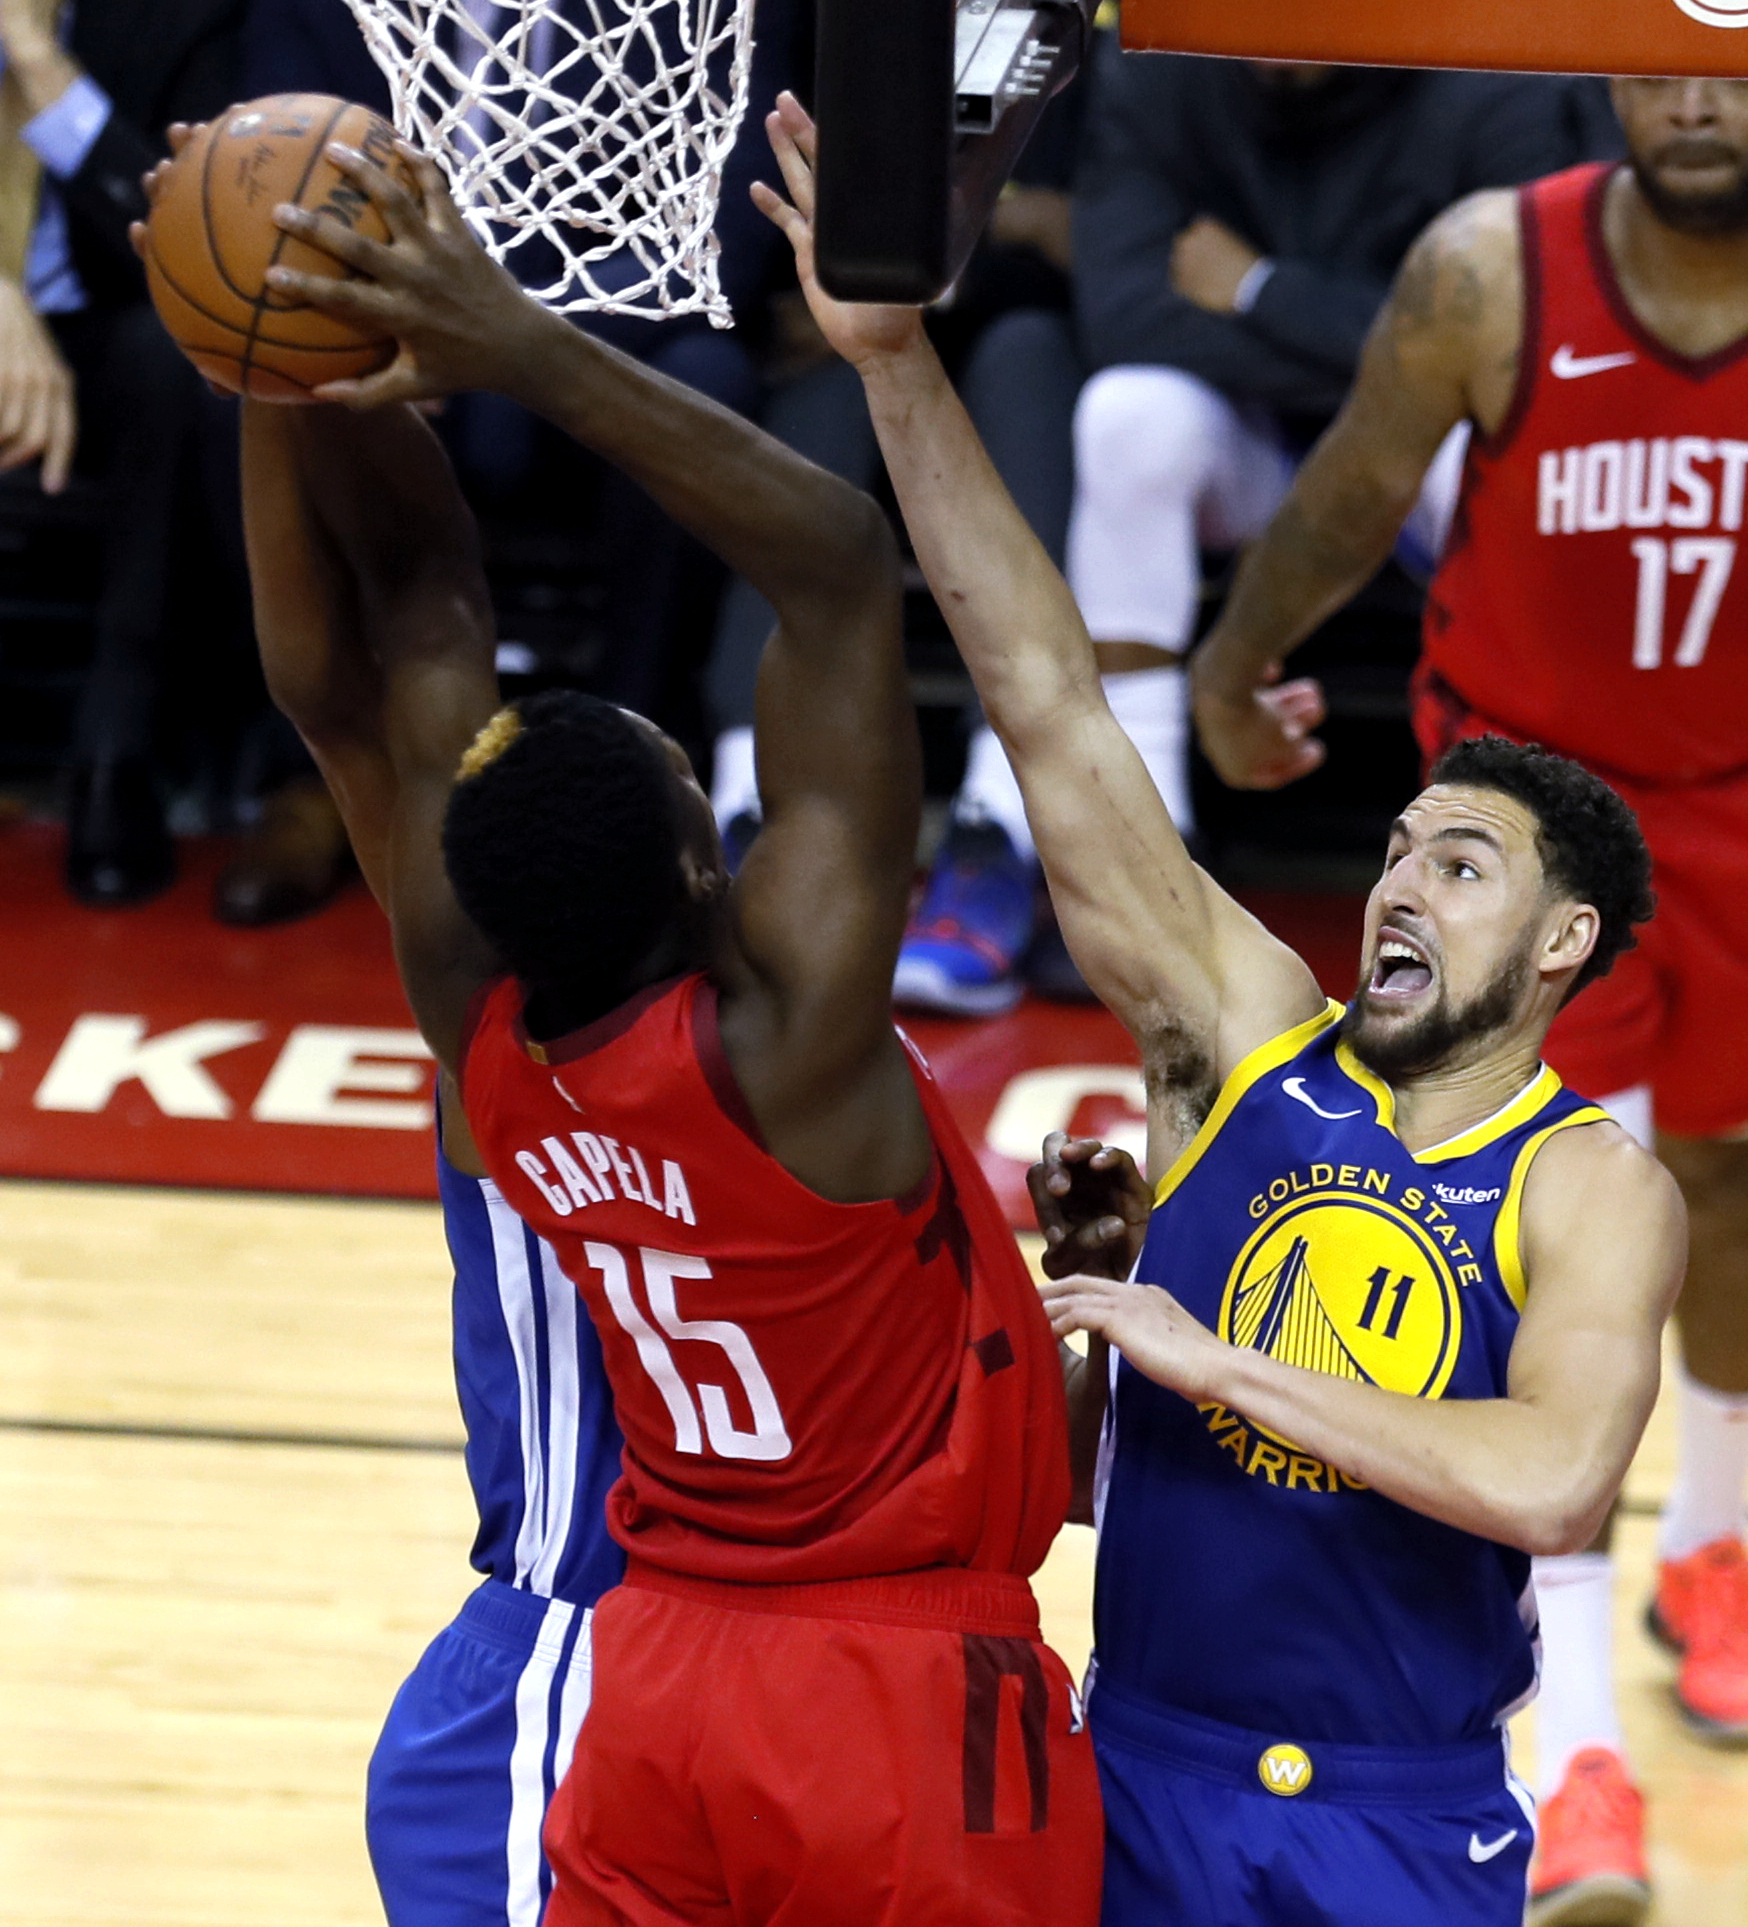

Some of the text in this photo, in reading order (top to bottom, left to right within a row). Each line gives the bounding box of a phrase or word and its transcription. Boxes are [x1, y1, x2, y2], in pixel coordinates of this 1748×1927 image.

[1630, 536, 1737, 670] 17
[0, 1011, 437, 1131] KE
[515, 1131, 697, 1226] CAPELA
[1249, 1163, 1483, 1288] GOLDEN STATE
[1432, 1183, 1500, 1203] kuten
[583, 1241, 792, 1460] 15
[1357, 1265, 1416, 1341] 11
[1267, 1757, 1306, 1786] W
